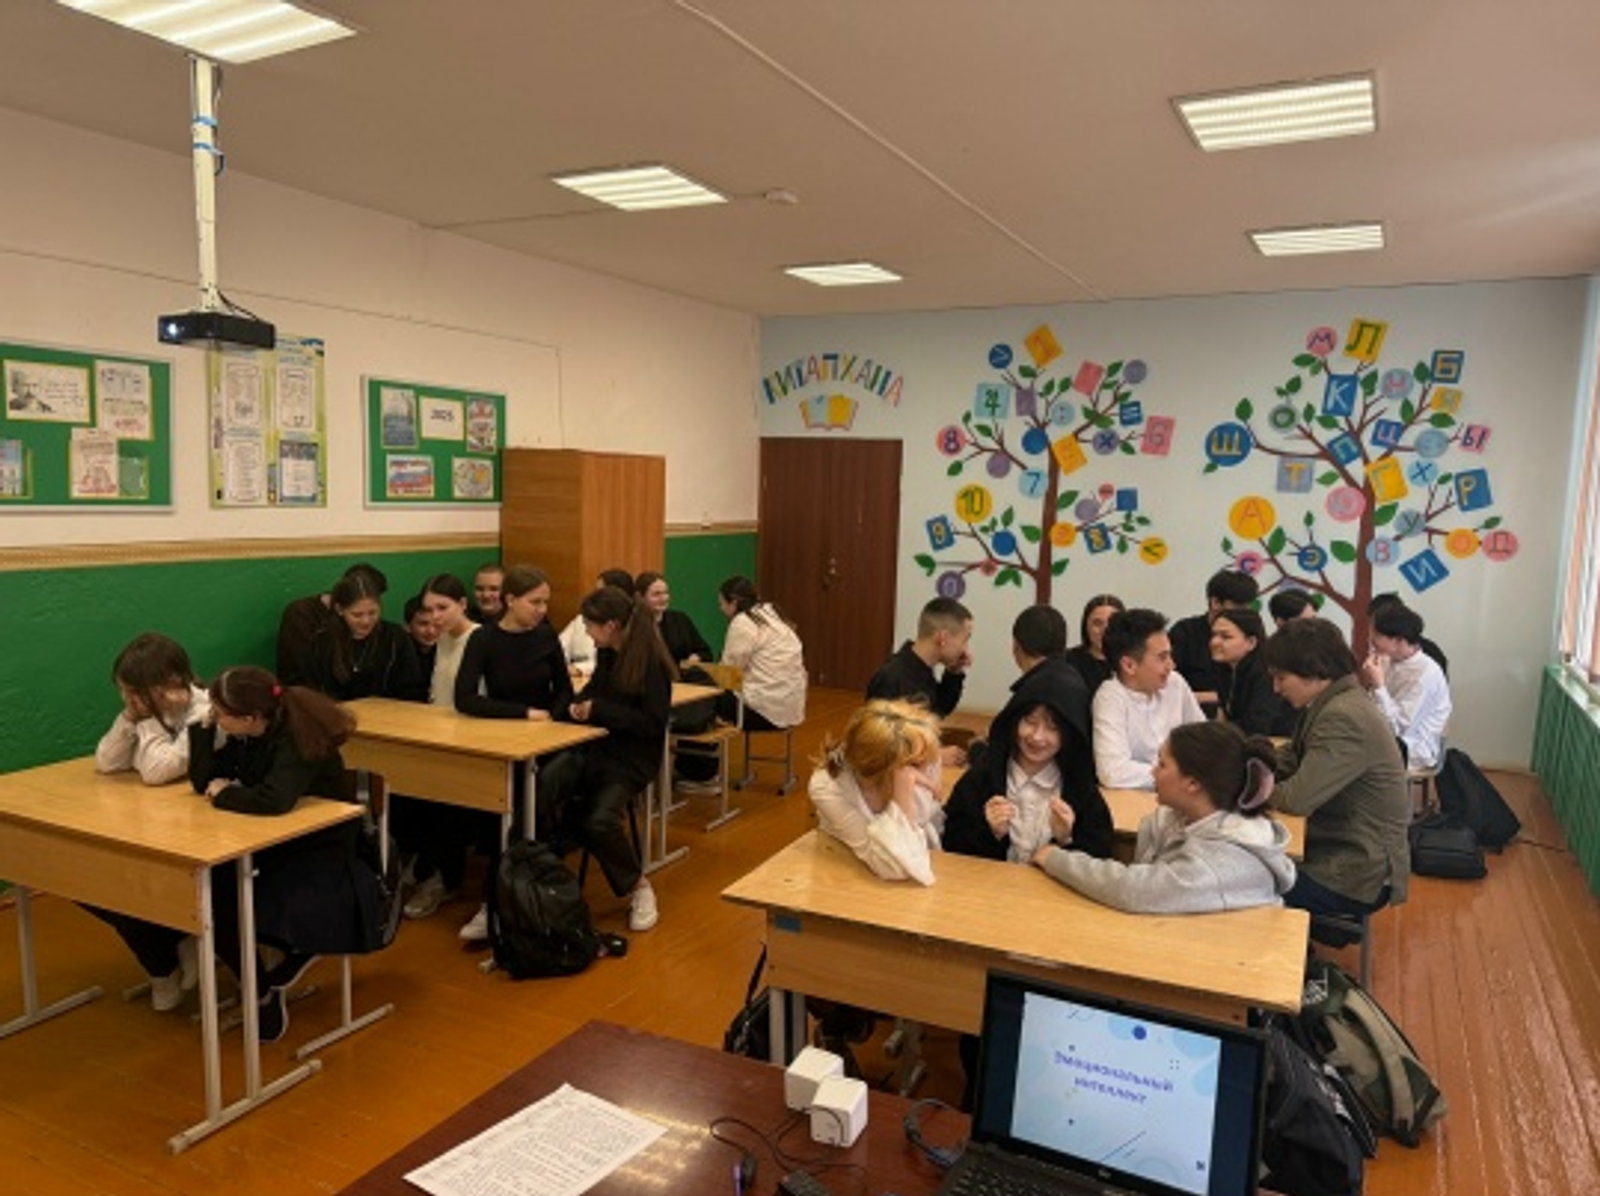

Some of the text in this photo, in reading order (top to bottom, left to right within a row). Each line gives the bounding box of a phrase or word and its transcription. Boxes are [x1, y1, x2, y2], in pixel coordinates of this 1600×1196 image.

[1345, 322, 1381, 354] Л
[1211, 430, 1242, 455] Ш
[1026, 472, 1040, 494] 7
[961, 486, 984, 515] 10
